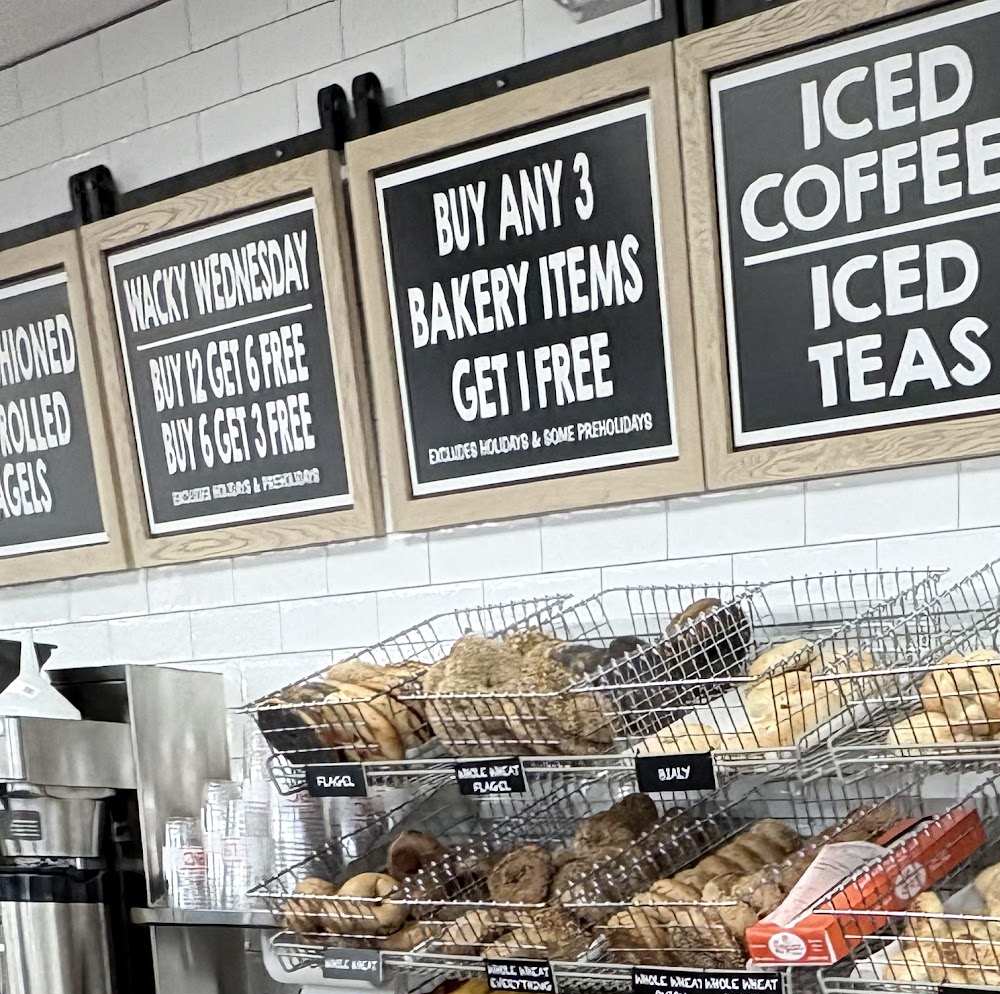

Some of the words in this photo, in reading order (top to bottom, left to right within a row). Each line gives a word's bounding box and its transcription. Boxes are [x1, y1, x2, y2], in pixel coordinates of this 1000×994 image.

[800, 44, 974, 151] ICED
[432, 180, 487, 257] BUY
[499, 159, 563, 241] ANY
[572, 152, 594, 221] 3
[123, 264, 190, 332] WACKY
[190, 229, 310, 315] WEDNESDAY
[407, 260, 530, 350] BAKERY
[539, 233, 644, 320] ITEMS
[810, 239, 979, 330] ICED
[148, 349, 184, 413] BUY
[206, 339, 244, 399] GET
[245, 335, 260, 392] 6
[259, 322, 310, 390] FREE
[451, 352, 510, 422] GET
[533, 331, 614, 410] FREE
[807, 316, 992, 408] TEAS
[160, 416, 197, 476] BUY
[199, 413, 215, 468] 6
[213, 405, 251, 465] GET
[250, 407, 267, 458] 3
[265, 392, 316, 455] FREE
[531, 430, 541, 449] &
[543, 424, 576, 447] SOME
[577, 412, 653, 442] PREHOLIDAYS
[704, 977, 740, 990] WHOLE
[741, 978, 779, 991] WHEAT
